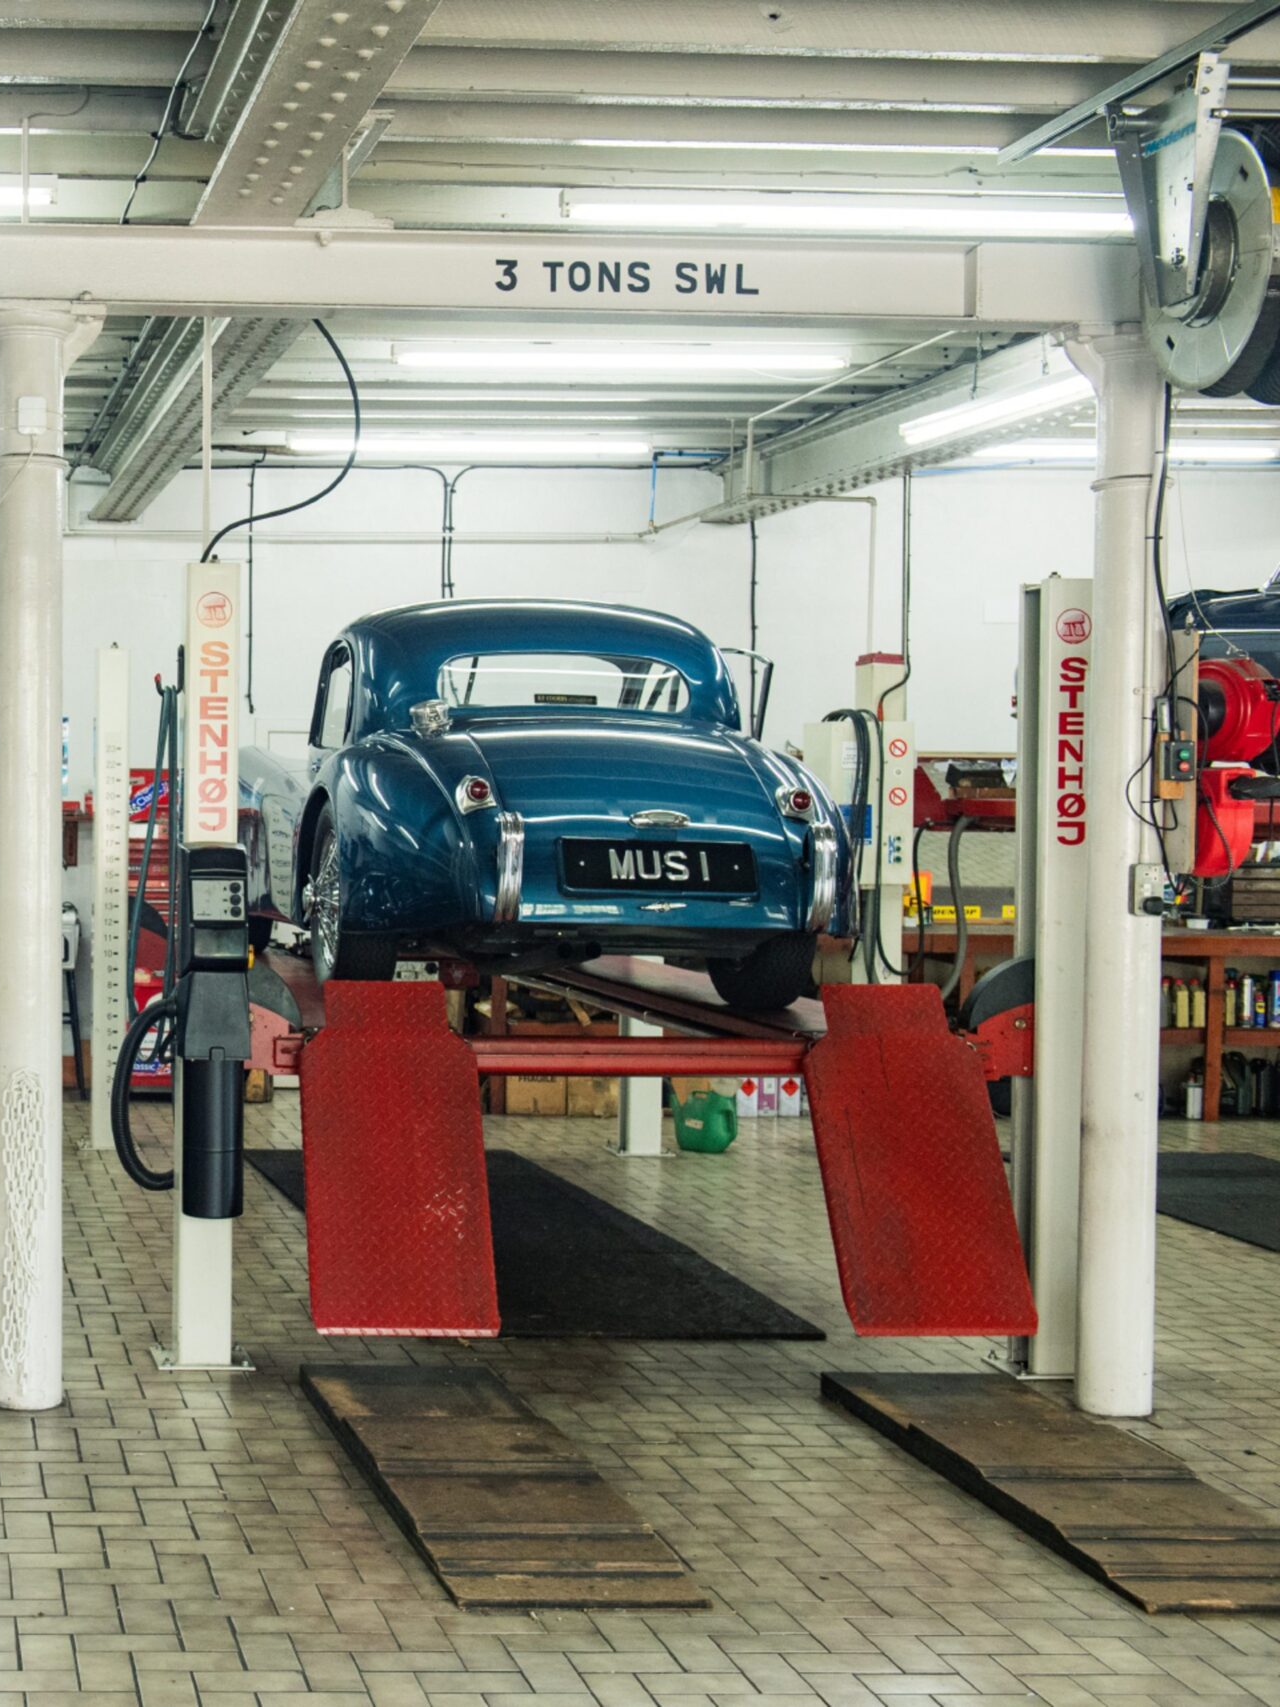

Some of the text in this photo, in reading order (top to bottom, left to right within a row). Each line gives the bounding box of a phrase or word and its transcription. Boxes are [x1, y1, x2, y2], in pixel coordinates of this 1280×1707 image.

[495, 259, 759, 295] 3 TONS SWL
[198, 640, 230, 832] STENHØJ
[1056, 656, 1089, 847] STENHØJ
[608, 848, 690, 881] MUS
